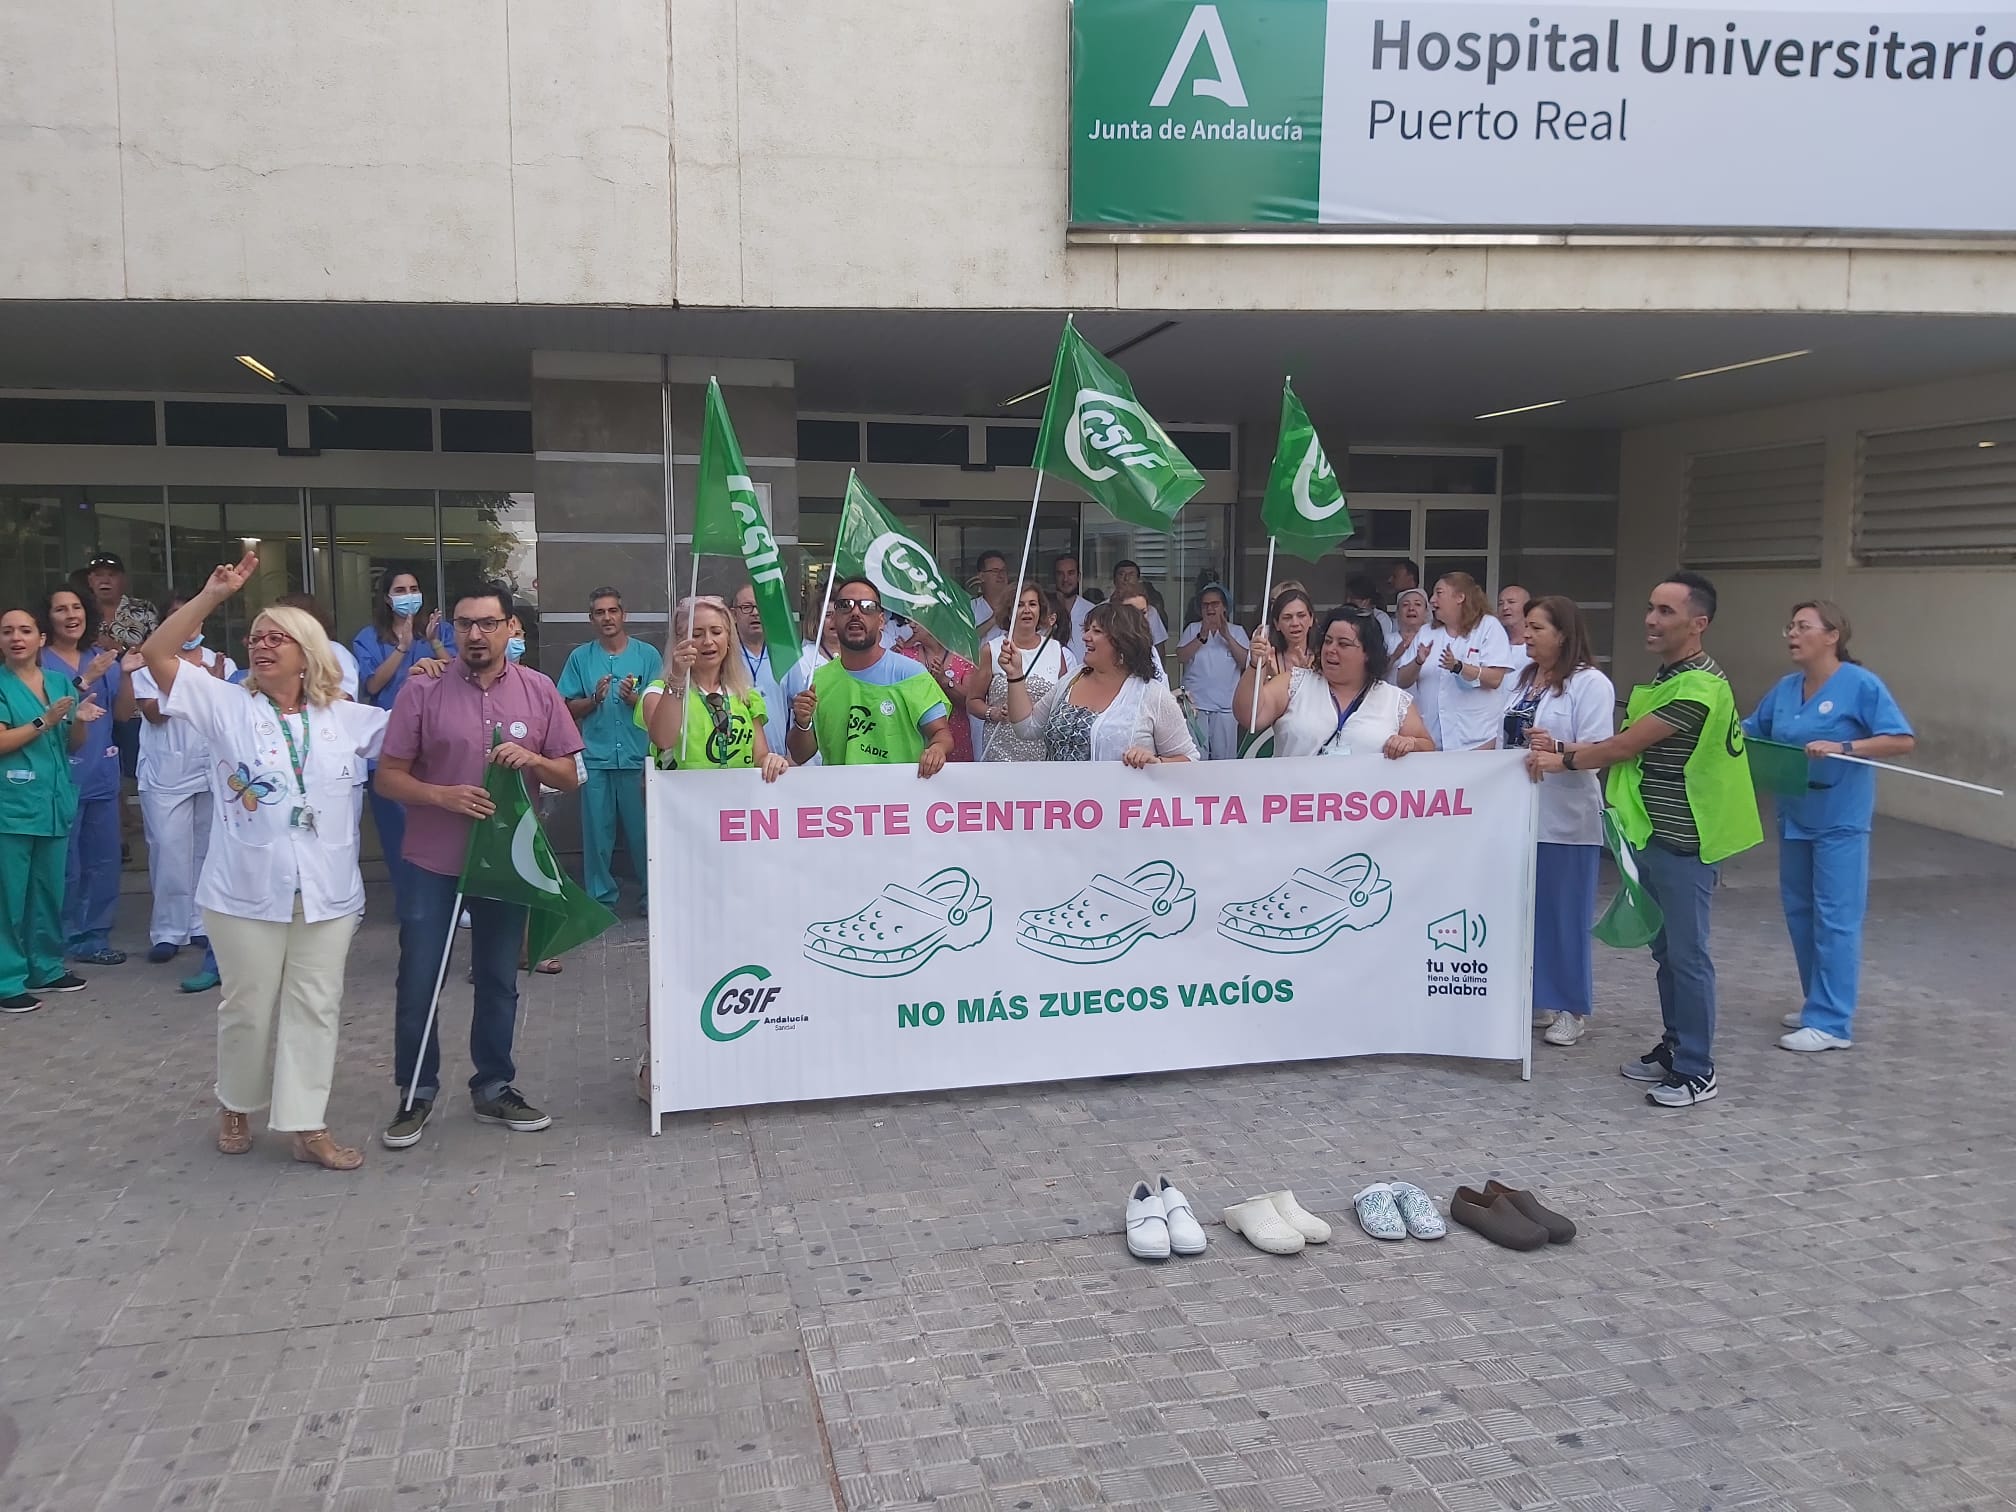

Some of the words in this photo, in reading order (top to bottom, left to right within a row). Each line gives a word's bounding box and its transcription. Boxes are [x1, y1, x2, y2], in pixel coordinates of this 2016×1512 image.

[1371, 17, 1620, 85] Hospital
[1641, 22, 2016, 80] Universitario
[1088, 119, 1152, 140] Junta
[1158, 118, 1186, 140] de
[1190, 116, 1304, 141] Andalucía
[1368, 100, 1519, 141] Puerto
[1534, 98, 1627, 141] Real
[1080, 409, 1170, 469] CSIF
[860, 743, 889, 759] CÁDIZ
[719, 808, 780, 842] EN
[797, 803, 910, 839] ESTE
[926, 799, 1103, 834] CENTRO
[1119, 795, 1248, 829] FALTA
[1262, 787, 1473, 823] PERSONAL
[1426, 958, 1444, 973] tu
[1450, 959, 1489, 974] voto
[1427, 974, 1449, 982] tiene
[1451, 975, 1460, 983] la
[1462, 974, 1487, 983] última
[716, 986, 782, 1015] CSIF
[897, 1002, 945, 1028] NO
[957, 990, 1029, 1024] MÁS
[1039, 986, 1169, 1018] ZUECOS
[1177, 978, 1294, 1009] VACÍOS
[1427, 982, 1487, 997] palabra
[764, 1014, 809, 1024] Andalucía
